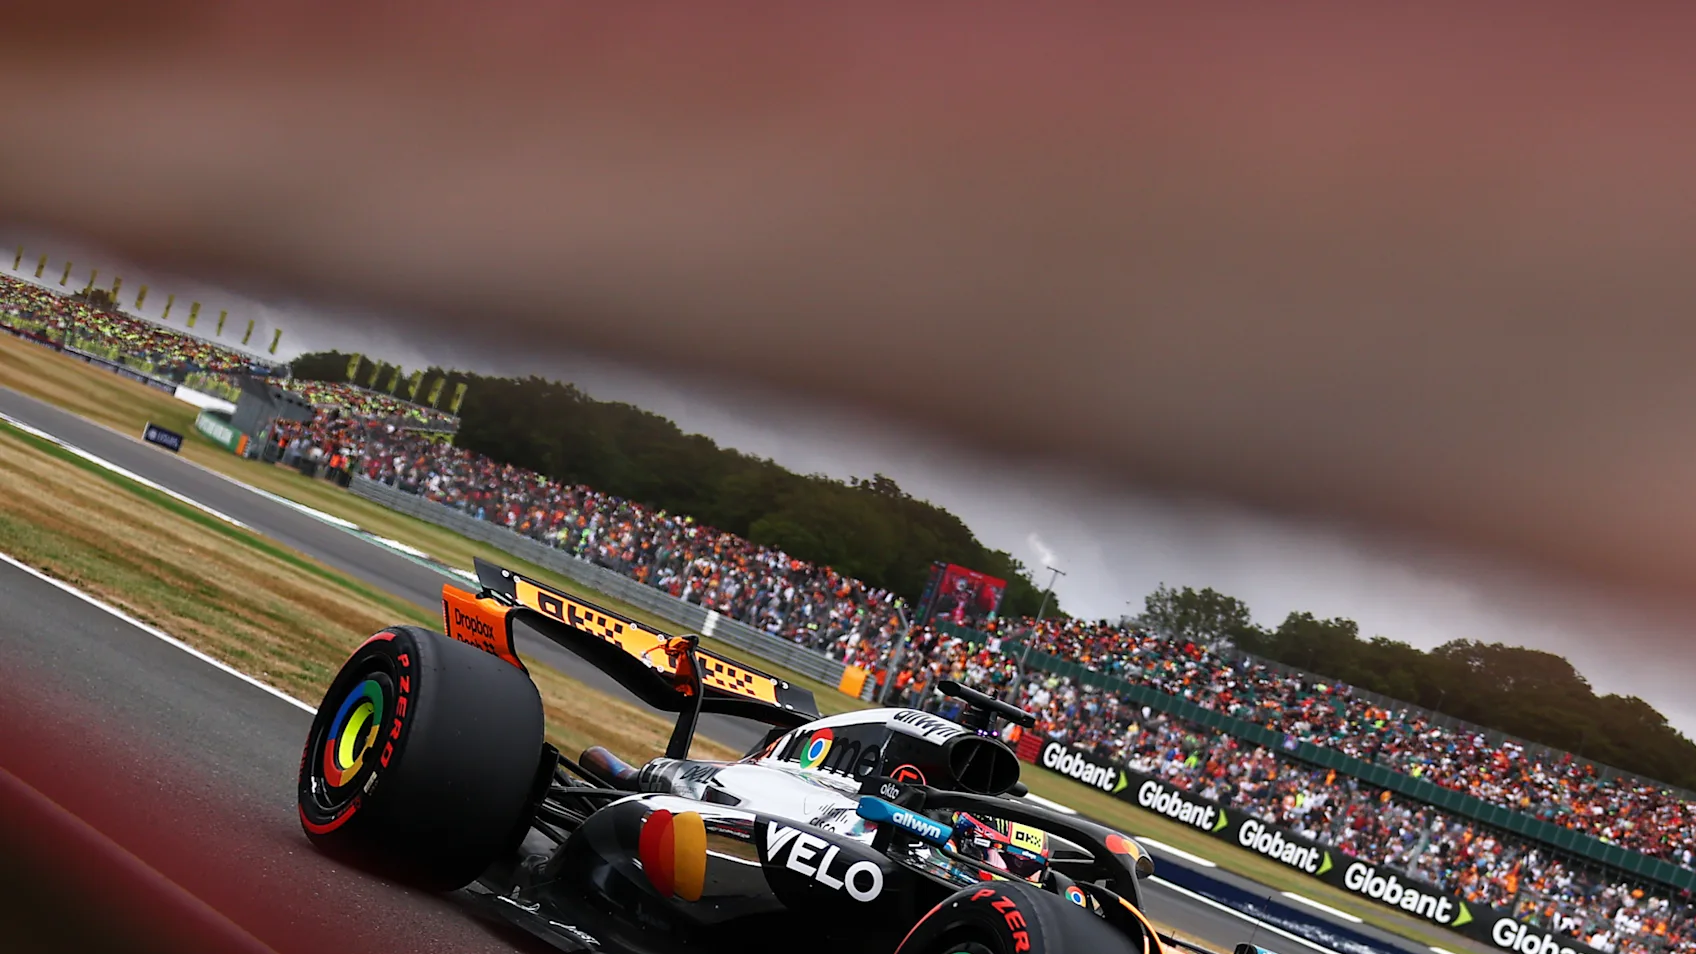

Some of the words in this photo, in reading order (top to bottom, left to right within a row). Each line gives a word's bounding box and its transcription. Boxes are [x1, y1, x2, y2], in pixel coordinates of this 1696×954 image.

[455, 607, 495, 640] Dropbox
[380, 675, 410, 768] ZERO
[893, 710, 960, 739] allwyn
[880, 783, 899, 799] okta
[1043, 741, 1116, 793] Globant
[892, 812, 941, 838] allwyn
[1138, 781, 1216, 833] Globant
[766, 820, 884, 902] VELO
[1016, 831, 1042, 847] OKX
[1238, 819, 1319, 875] Globant
[1344, 862, 1453, 925] Globant
